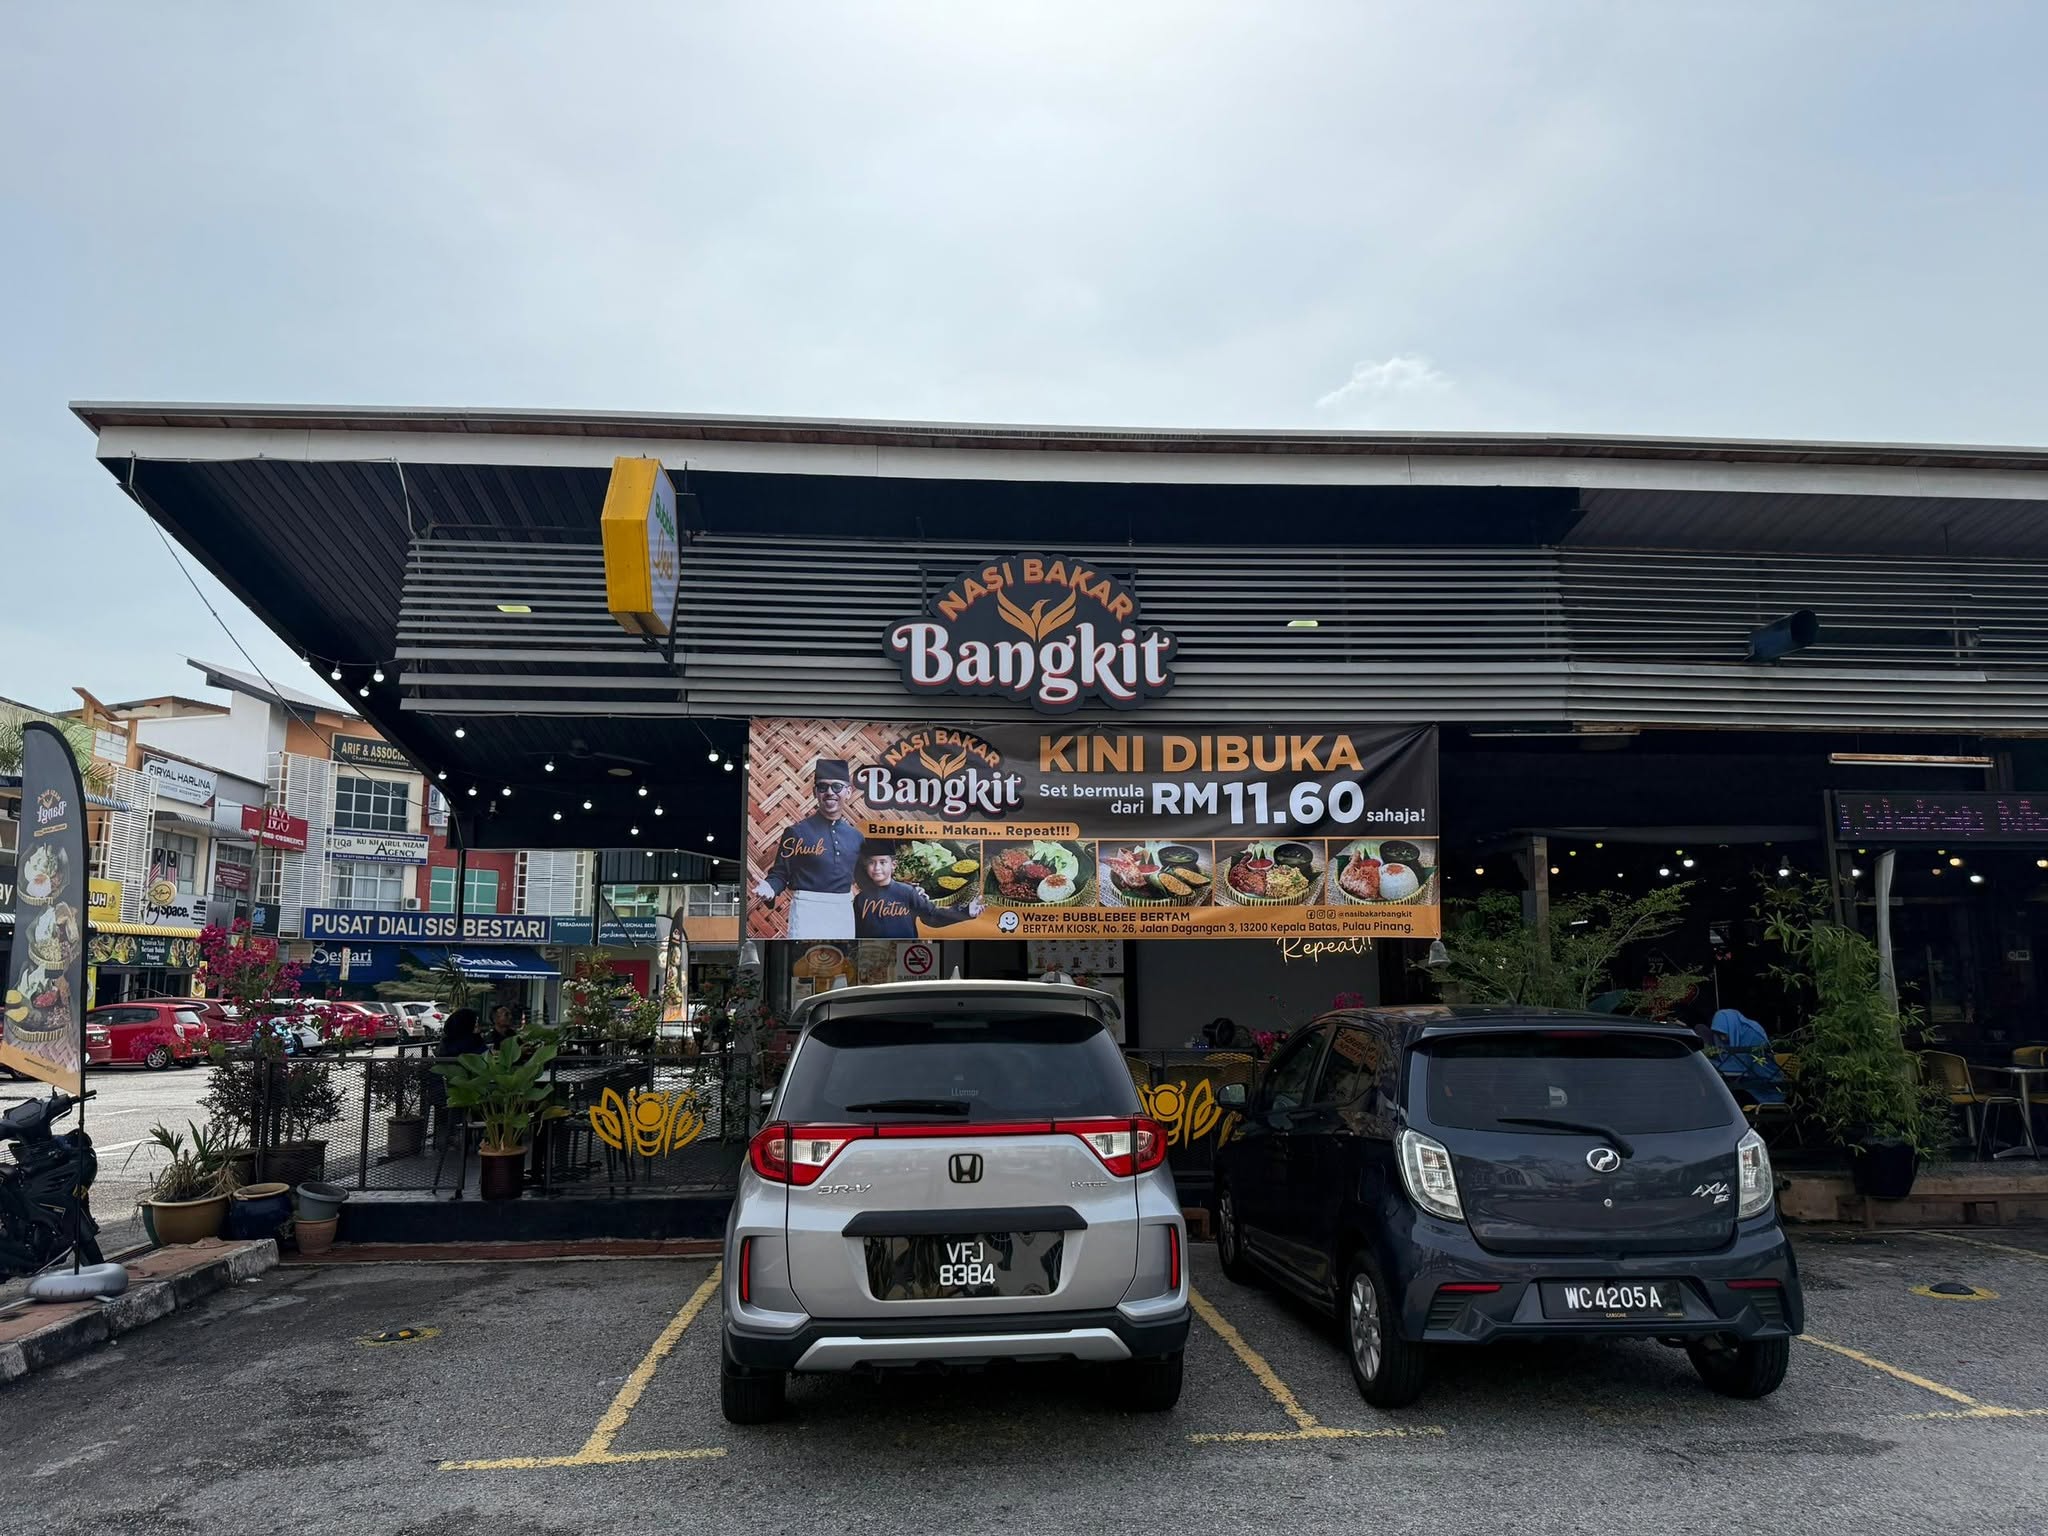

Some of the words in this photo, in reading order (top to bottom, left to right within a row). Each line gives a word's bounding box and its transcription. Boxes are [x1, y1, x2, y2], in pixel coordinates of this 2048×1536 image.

[938, 562, 1014, 623] NASI
[1023, 558, 1134, 623] BAKAR
[891, 622, 1171, 705] Bangkit
[341, 742, 361, 755] ARIF
[362, 744, 369, 756] &
[884, 731, 929, 767] NASI
[935, 729, 1000, 768] BAKAR
[1039, 735, 1144, 773] KINI
[1162, 734, 1364, 773] DIBUKA
[856, 767, 1021, 815] Bangkit
[1039, 784, 1069, 797] Set
[1073, 784, 1145, 797] bermula
[1110, 799, 1145, 814] dari
[1151, 779, 1366, 826] RM11.60
[1366, 809, 1426, 825] sahaja!
[868, 823, 938, 837] Bangkit...
[942, 825, 1001, 836] Makan...
[1005, 825, 1070, 838] Repeat!!!
[374, 842, 416, 857] AGENCY
[780, 837, 827, 859] Shuib
[862, 897, 911, 920] Matin
[1022, 912, 1059, 922] Waze:
[1063, 912, 1136, 922] BUBBLEBEE
[1140, 912, 1190, 922] BERTAM
[311, 913, 374, 934] PUSAT
[378, 916, 457, 937] DIALISIS
[463, 918, 546, 938] BESTARI
[1022, 924, 1066, 934] BERTAM
[1066, 924, 1100, 935] KIOSK,
[1103, 924, 1120, 933] No.
[1122, 924, 1137, 935] 26,
[1139, 923, 1169, 934] Jalan
[1171, 923, 1226, 935] Dagangan
[1228, 922, 1238, 933] 3,
[1240, 922, 1268, 932] 13200
[1270, 922, 1306, 934] Kepala
[1308, 922, 1340, 933] Batas,
[1342, 921, 1372, 932] Pulau
[1373, 921, 1414, 934] Pinang.
[817, 1183, 873, 1195] BR-V
[1691, 1181, 1731, 1197] AXIA
[945, 1242, 984, 1264] VFJ
[939, 1263, 996, 1287] 8384
[1564, 1286, 1663, 1310] WC4205A
